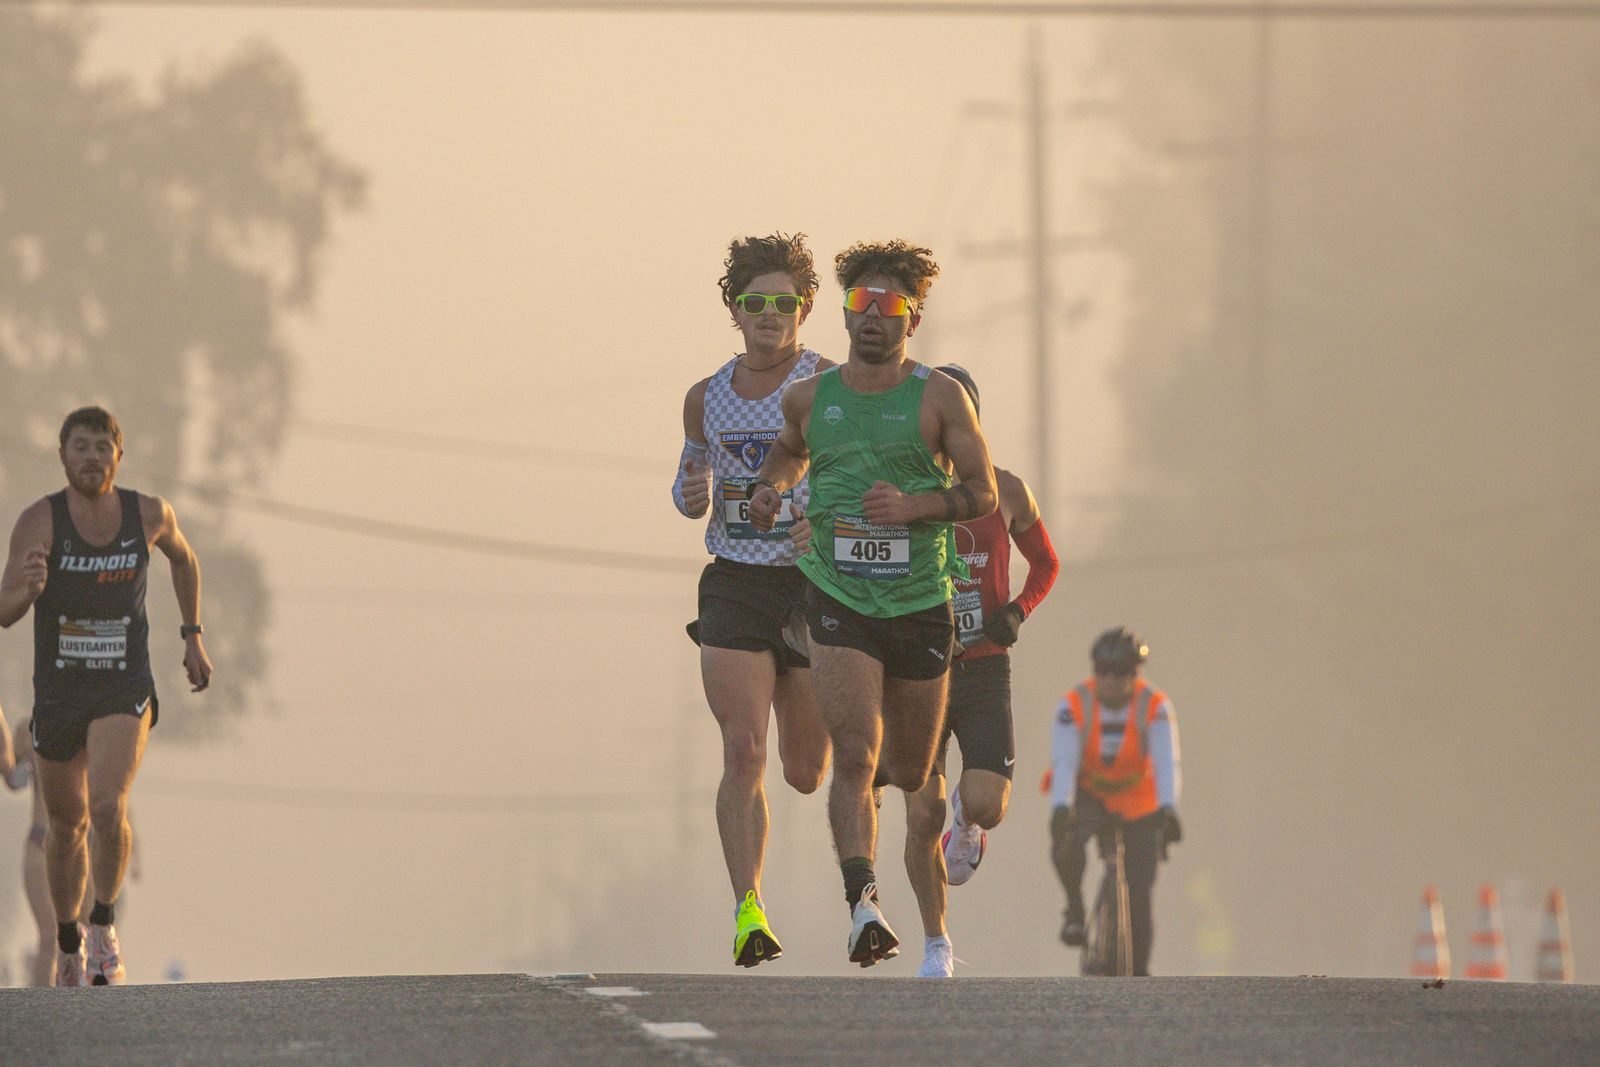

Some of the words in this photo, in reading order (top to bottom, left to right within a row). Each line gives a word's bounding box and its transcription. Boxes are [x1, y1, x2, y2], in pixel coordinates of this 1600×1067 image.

[722, 432, 776, 442] EMBRY-RIDDL
[854, 523, 909, 532] INTERNATIONAL
[850, 541, 892, 561] 405
[60, 553, 138, 572] ILLINOIS
[60, 640, 125, 653] LUSTGARTEN
[86, 659, 113, 669] ELITE
